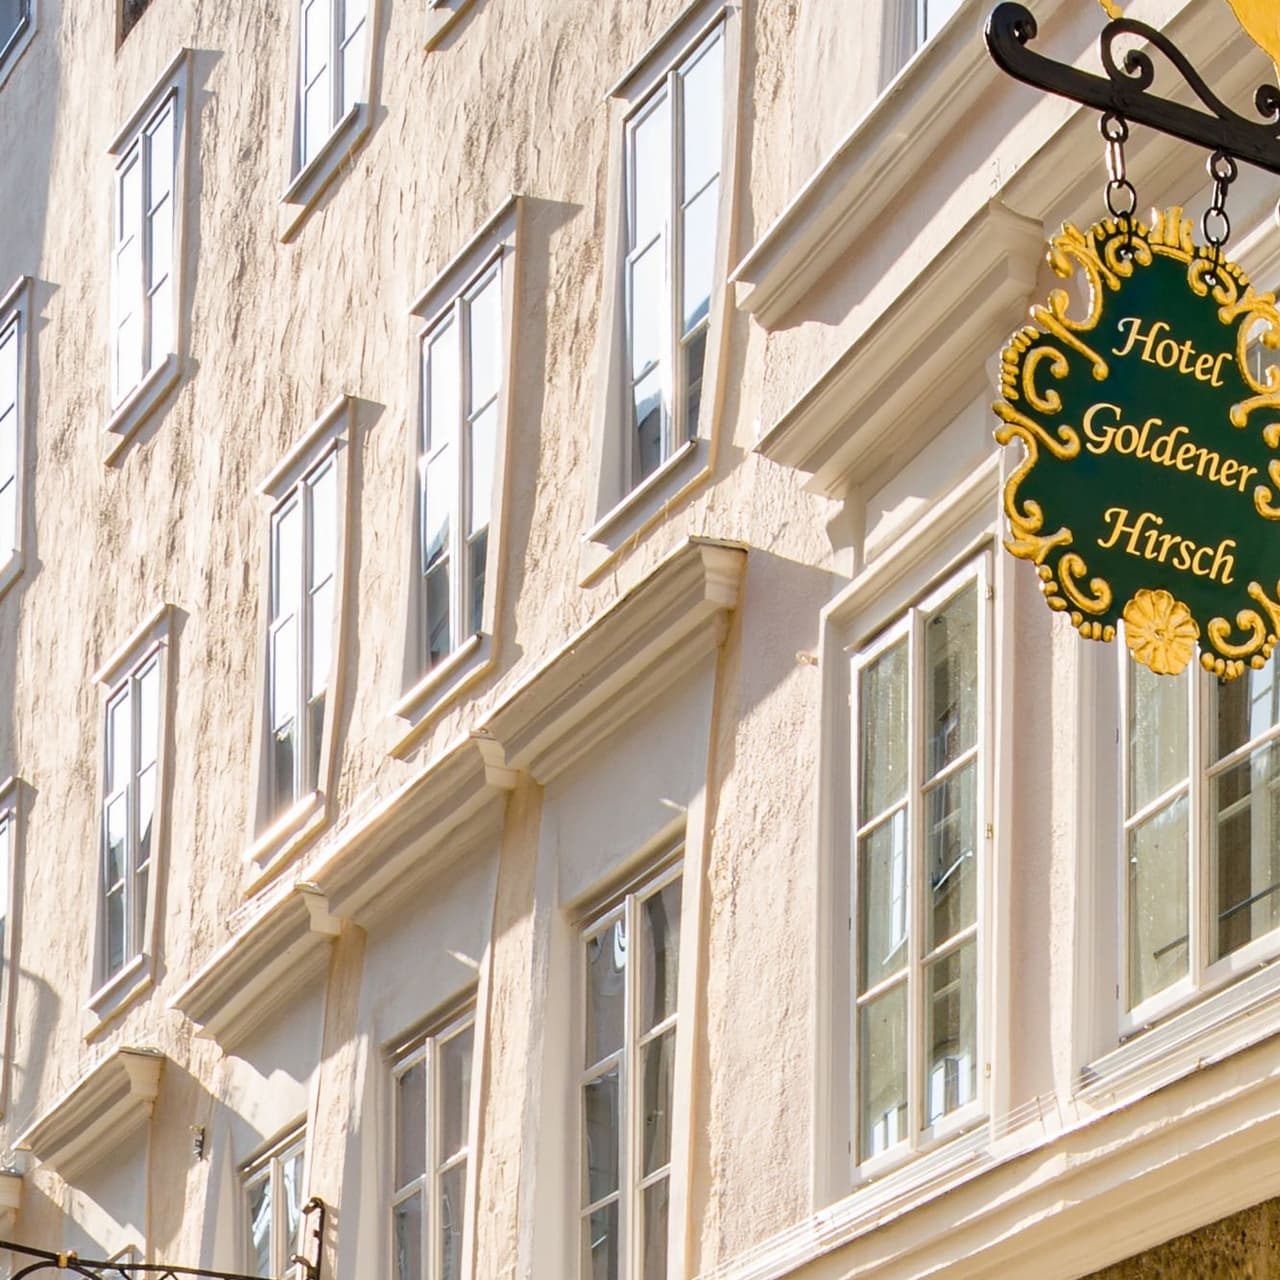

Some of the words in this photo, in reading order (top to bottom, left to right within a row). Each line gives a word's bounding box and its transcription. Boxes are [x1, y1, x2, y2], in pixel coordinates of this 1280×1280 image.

[1112, 317, 1232, 388] Hotel
[1083, 403, 1258, 493] Goldener
[1097, 507, 1237, 585] Hirsch
